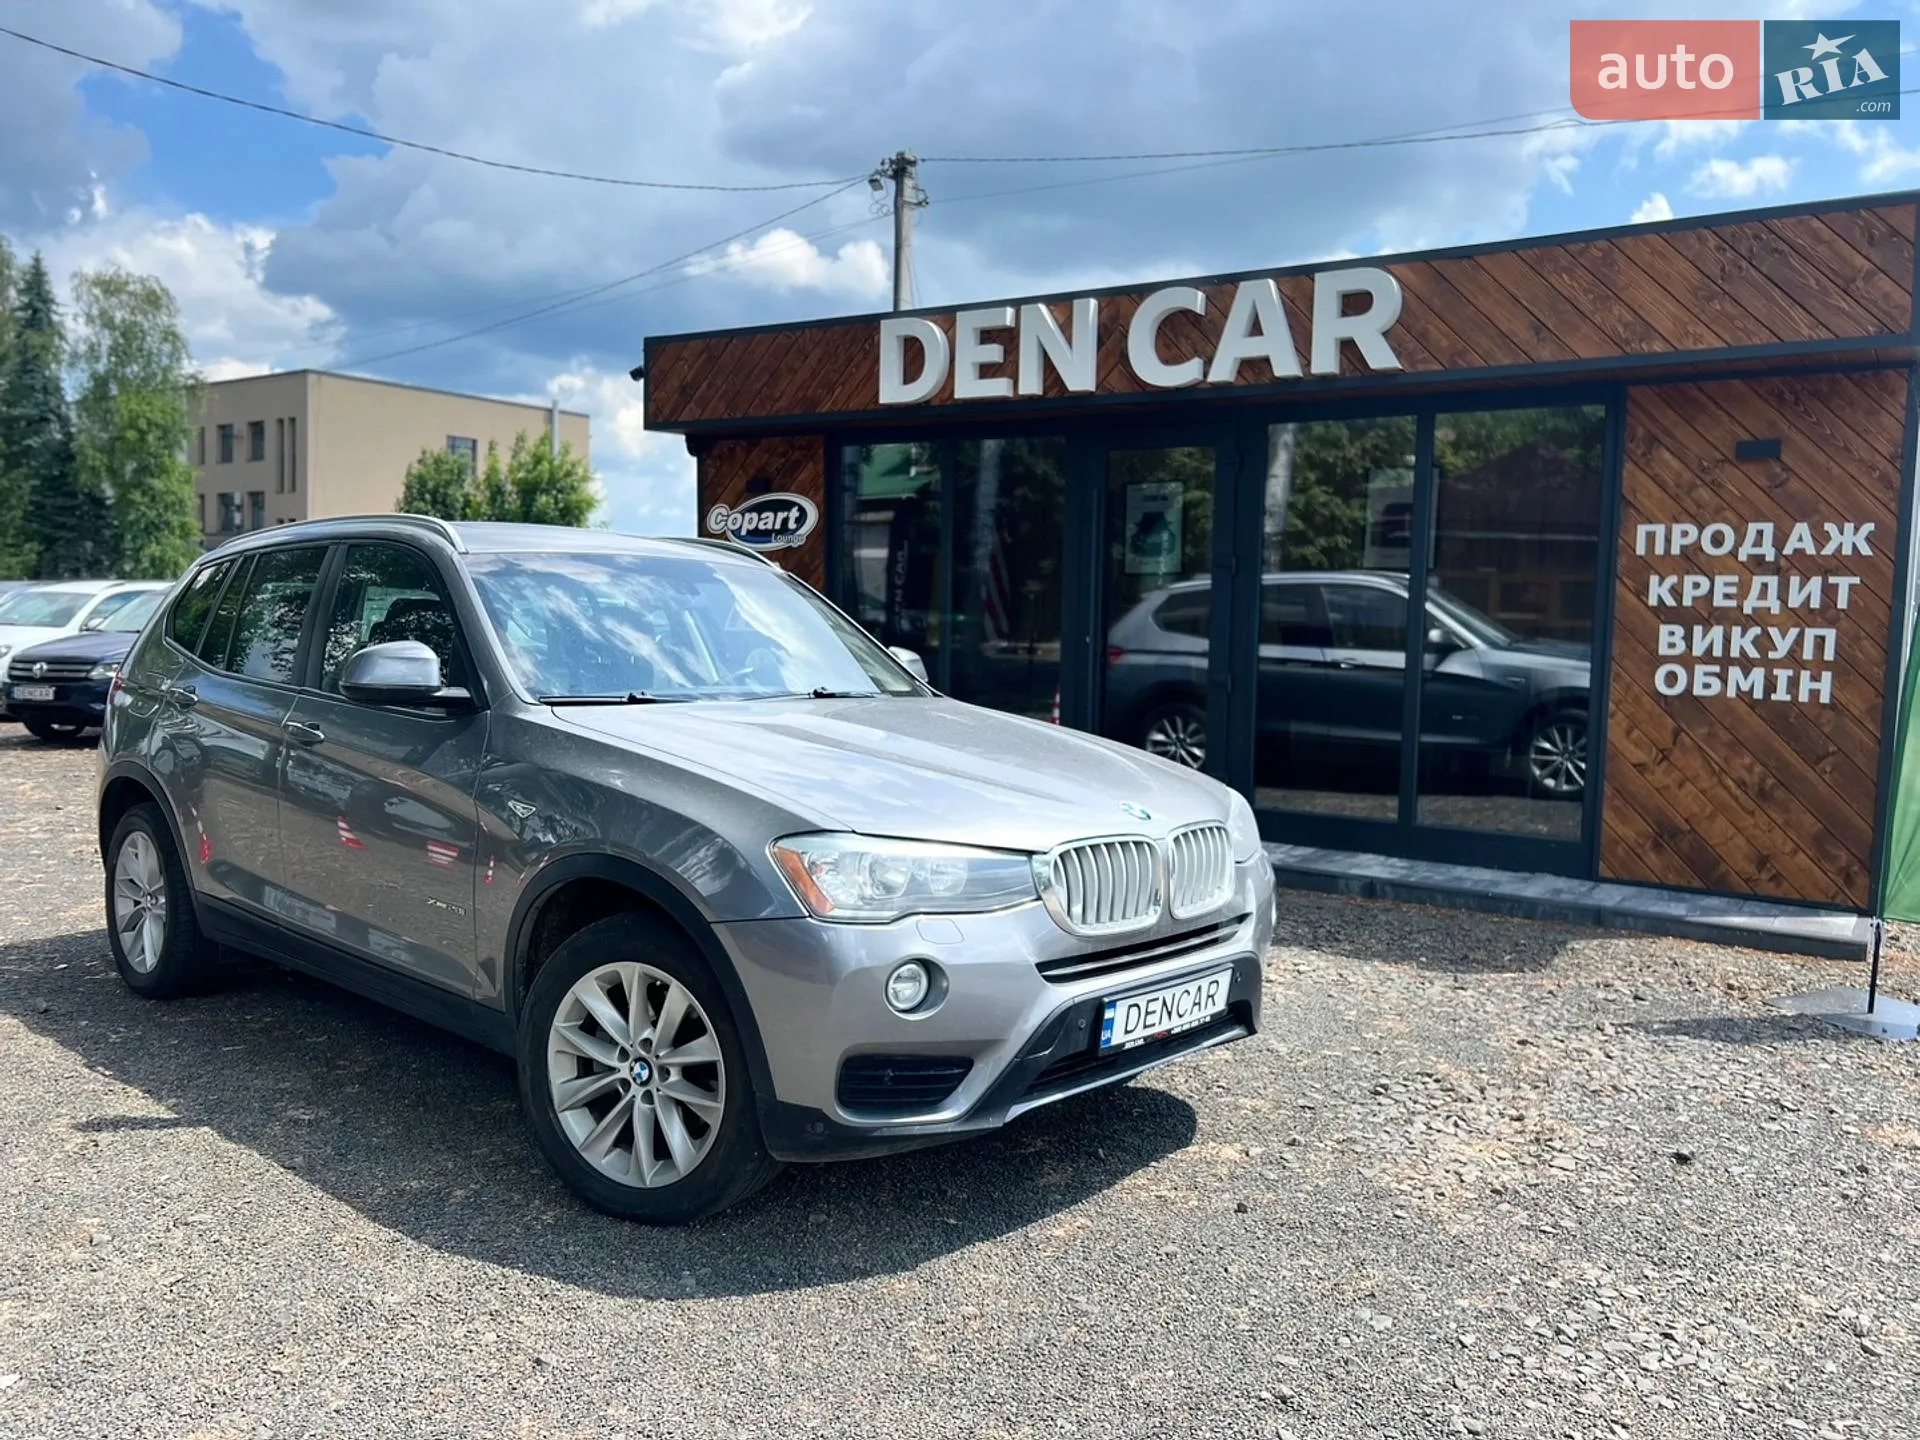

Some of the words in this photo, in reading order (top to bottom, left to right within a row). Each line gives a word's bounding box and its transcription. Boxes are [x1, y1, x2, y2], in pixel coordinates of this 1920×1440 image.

[879, 297, 1099, 404] DEN
[1127, 266, 1404, 388] CAR
[709, 506, 799, 535] Copart
[771, 533, 805, 546] Lounge
[1635, 521, 1876, 563] ПРОДАЖ
[1648, 573, 1861, 615] КРЕДИТ
[1657, 623, 1837, 662] ВИКУП
[1653, 662, 1833, 705] ОБМІН
[1124, 979, 1220, 1035] DENCAR
